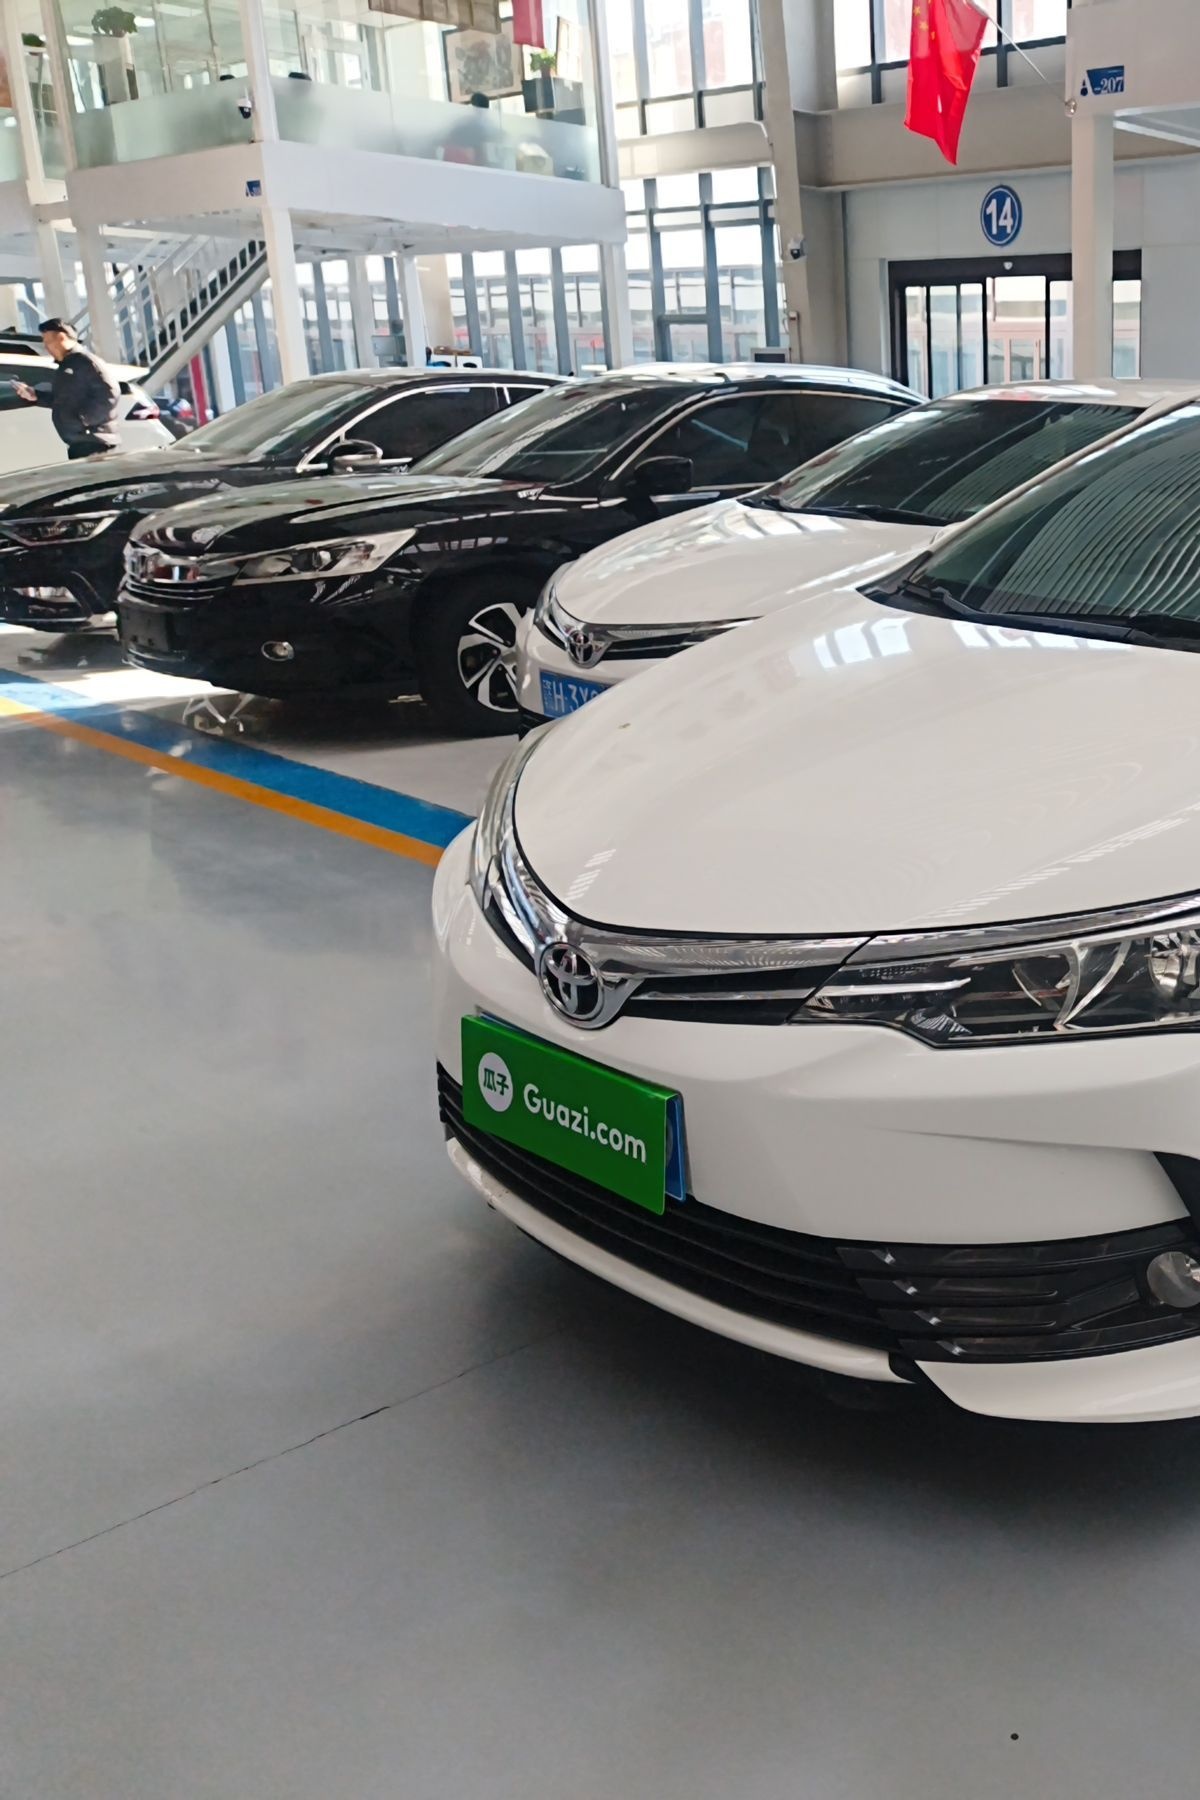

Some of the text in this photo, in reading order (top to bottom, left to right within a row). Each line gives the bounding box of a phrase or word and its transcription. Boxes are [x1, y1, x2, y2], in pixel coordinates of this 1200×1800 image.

[986, 197, 1013, 235] 14
[483, 1067, 510, 1096] 瓜子
[523, 1083, 647, 1163] Guazi.com
